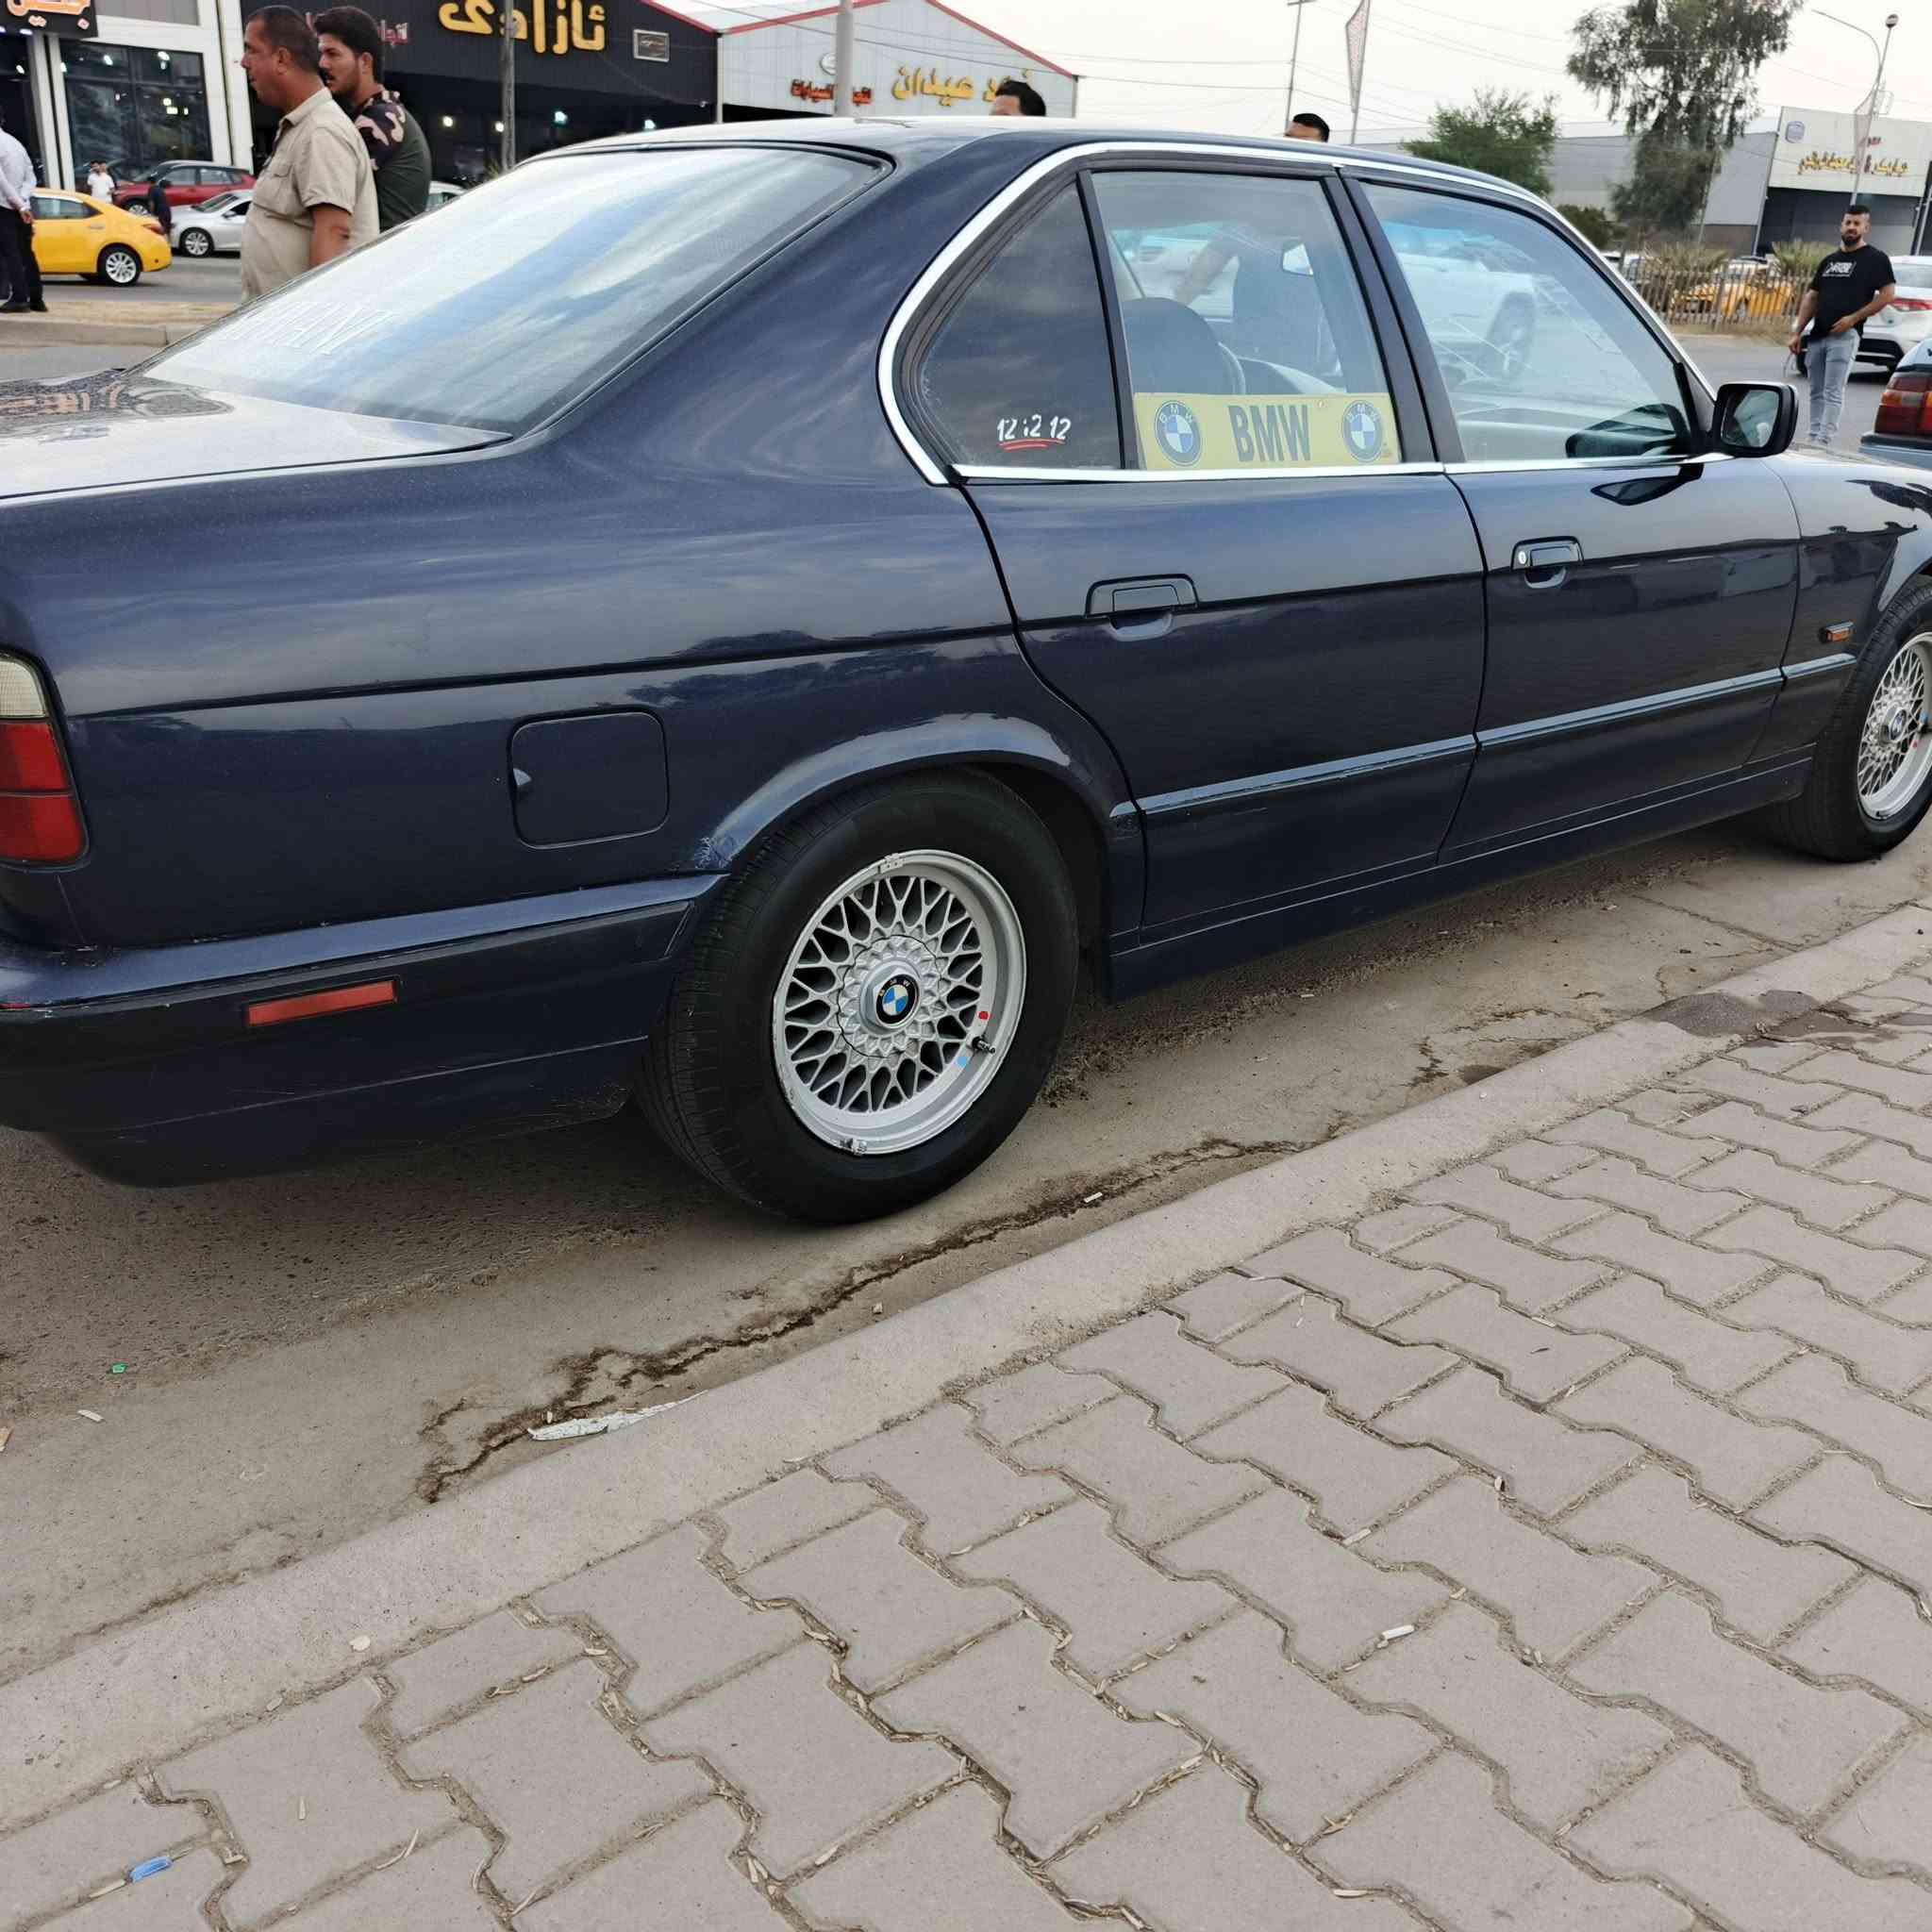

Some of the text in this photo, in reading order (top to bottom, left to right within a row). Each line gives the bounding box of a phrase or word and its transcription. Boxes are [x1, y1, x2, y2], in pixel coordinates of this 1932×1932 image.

[997, 418, 1018, 441] 12
[1049, 415, 1072, 441] 12
[1228, 405, 1311, 462] BMW
